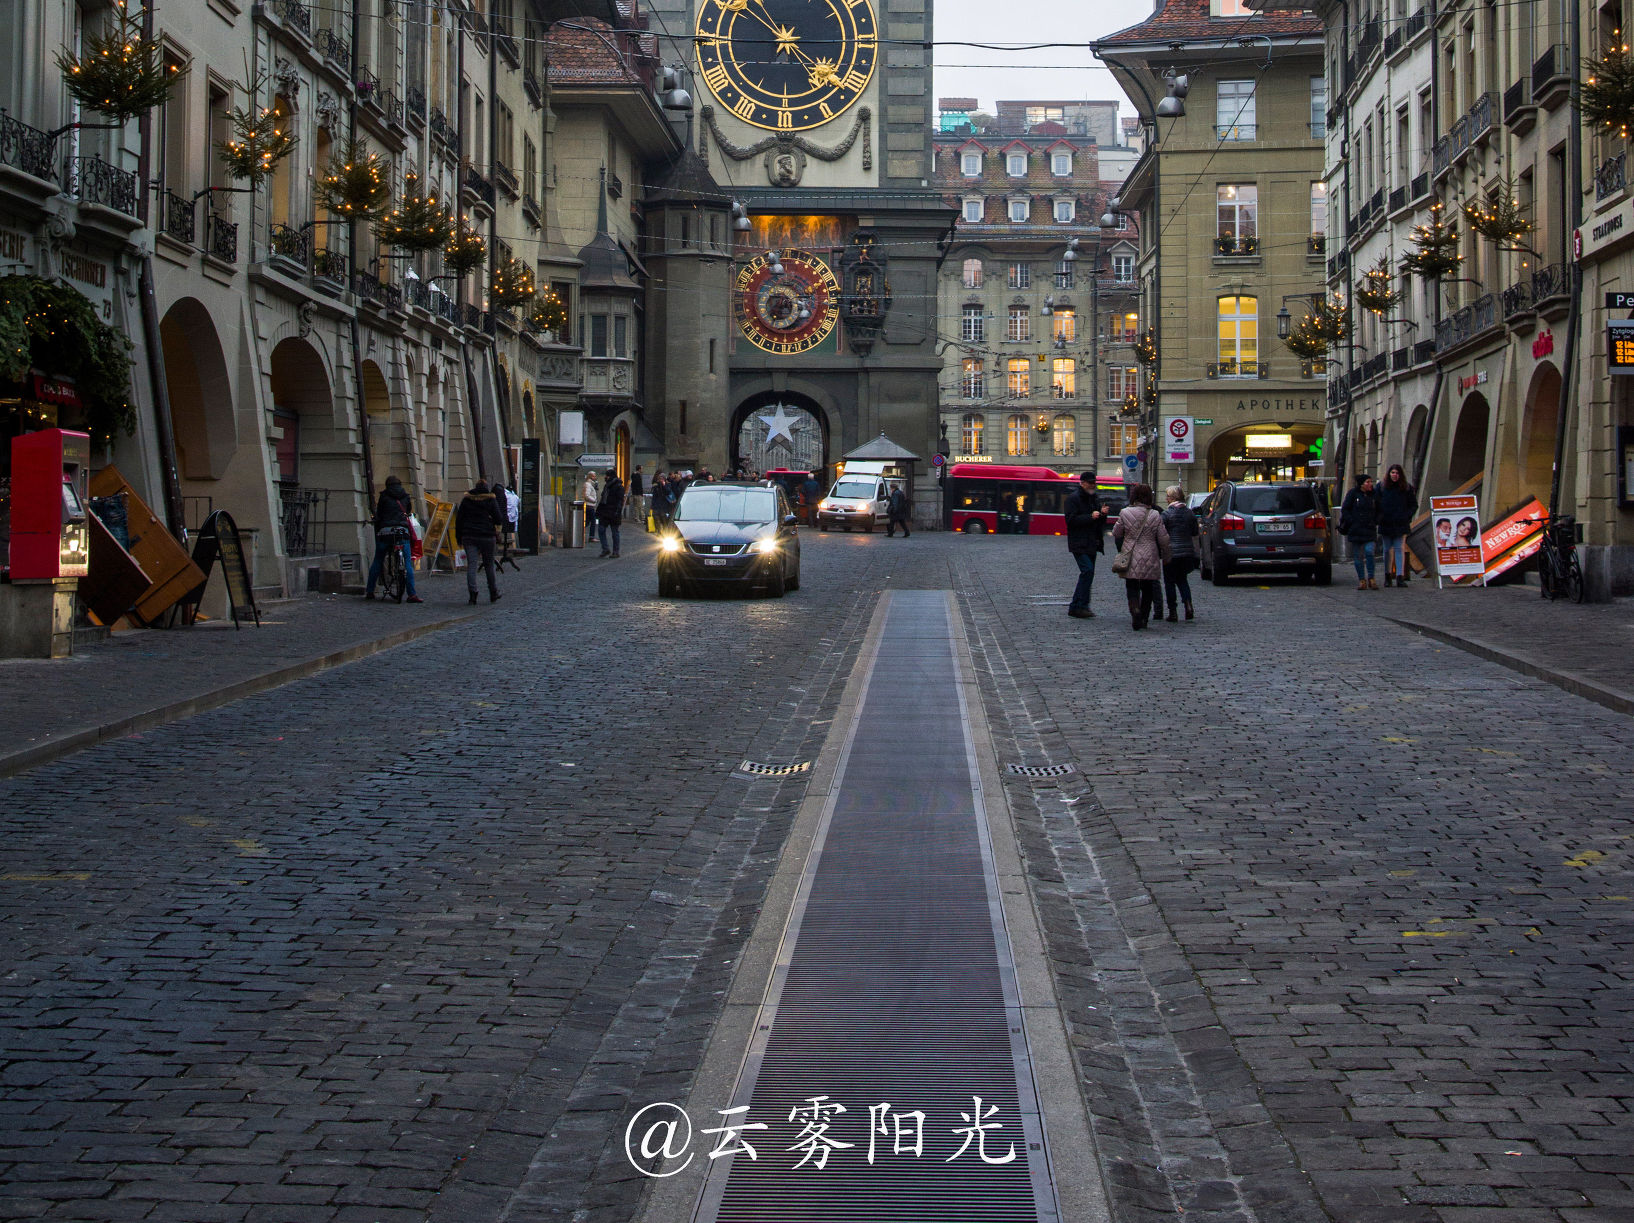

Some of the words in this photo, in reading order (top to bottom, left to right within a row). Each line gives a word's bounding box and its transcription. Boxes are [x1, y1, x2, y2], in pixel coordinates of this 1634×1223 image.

[858, 33, 875, 49] II
[0, 230, 26, 263] ERIE
[1236, 399, 1328, 410] APOTHEK
[954, 455, 993, 463] BUCHERER
